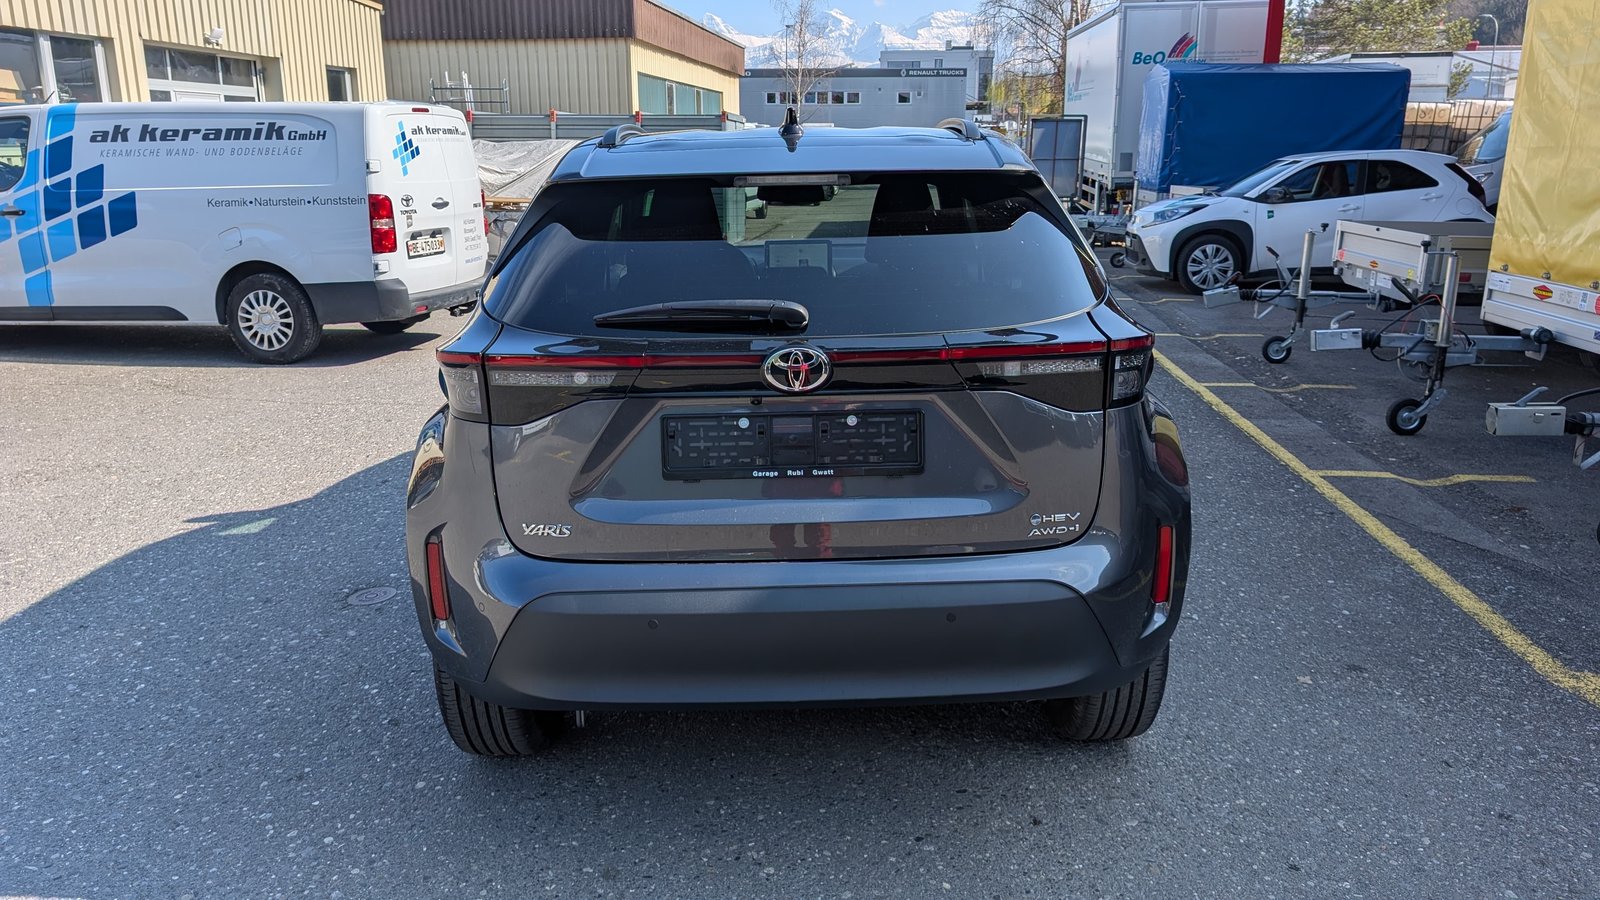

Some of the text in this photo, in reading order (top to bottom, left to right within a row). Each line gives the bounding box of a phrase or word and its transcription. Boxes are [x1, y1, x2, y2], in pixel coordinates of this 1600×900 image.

[89, 121, 327, 143] ak keramik GmbH
[411, 125, 424, 135] ak
[425, 125, 460, 135] keramik
[99, 146, 303, 158] KERAMISCHE WAND- UND BODENBELÄGE
[752, 470, 779, 478] Garage
[1042, 512, 1081, 523] HEV
